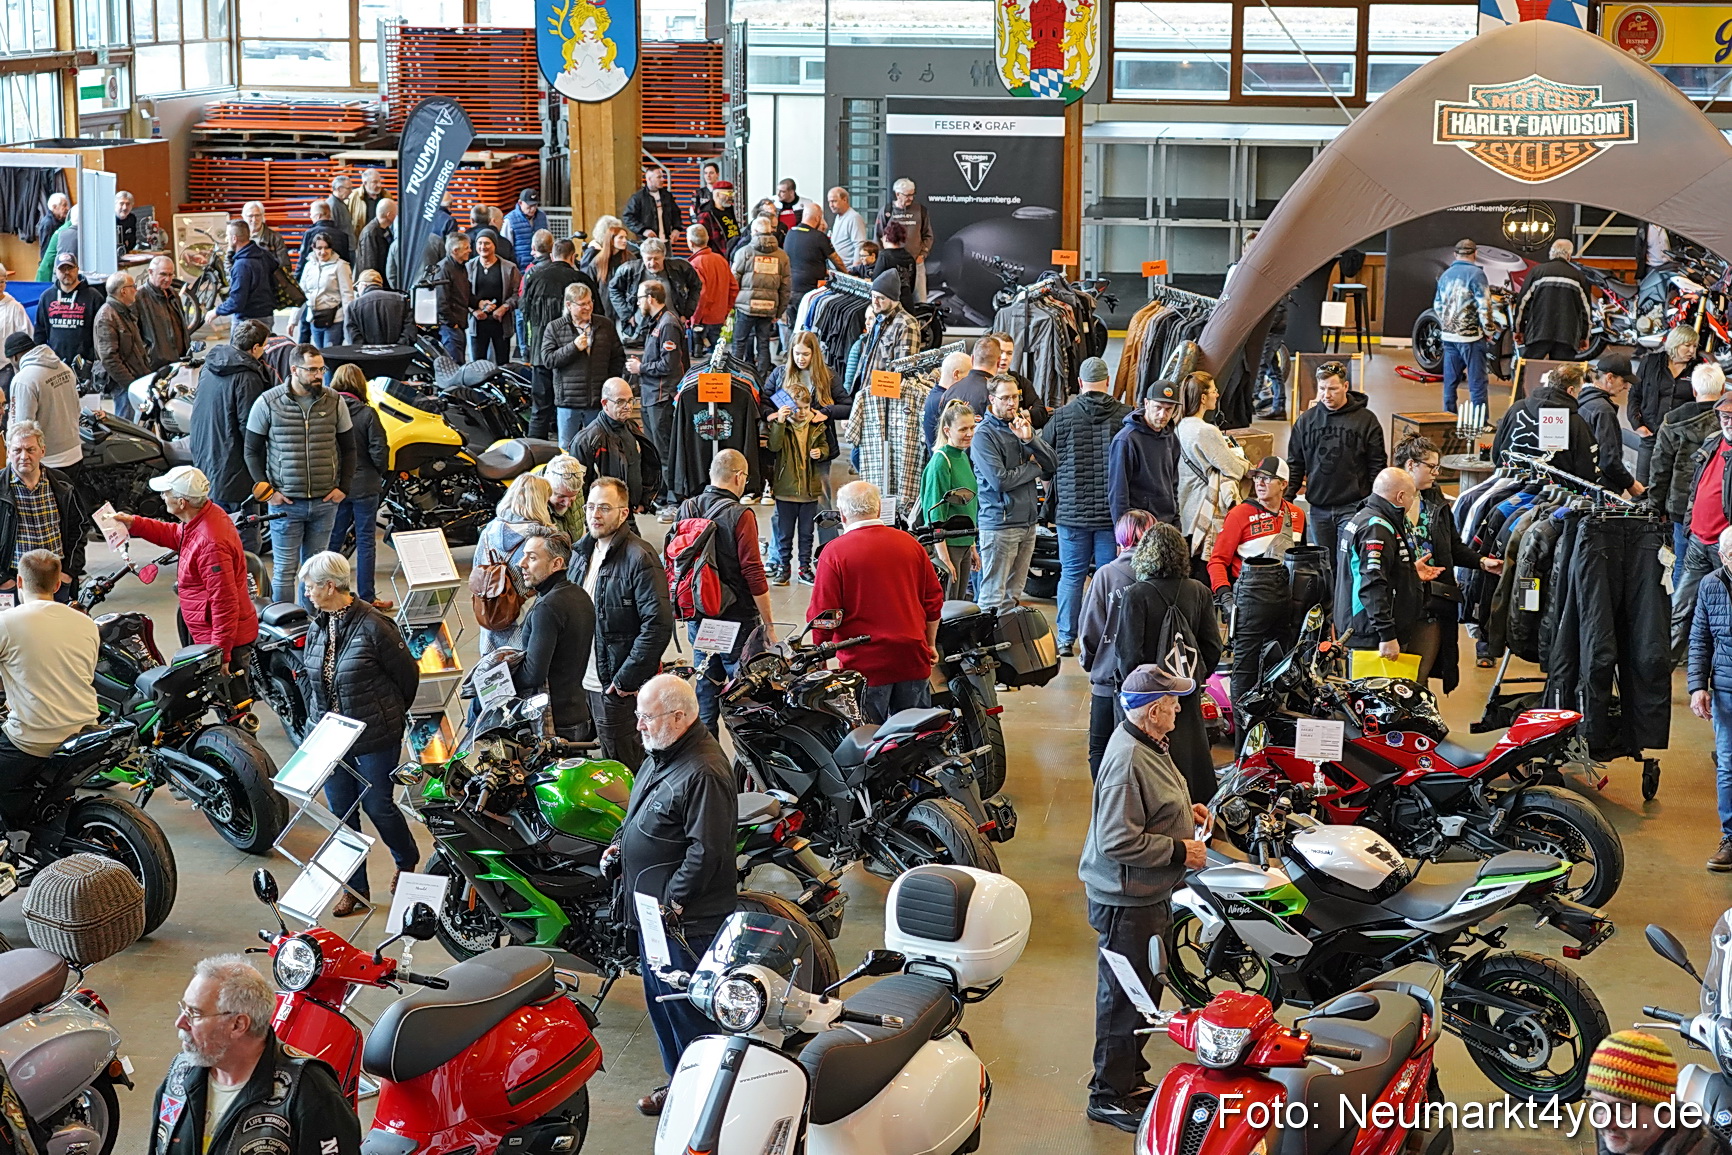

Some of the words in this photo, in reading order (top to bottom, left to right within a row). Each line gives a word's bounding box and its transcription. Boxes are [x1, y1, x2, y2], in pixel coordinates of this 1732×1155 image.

[1491, 87, 1582, 109] MOTOR
[934, 120, 971, 130] FESER
[984, 121, 1017, 131] GRAF
[1451, 112, 1620, 136] HARLEY-DAVIDSON
[406, 125, 446, 195] TRIUMPH
[961, 154, 989, 162] TRIUMPH
[1489, 142, 1581, 172] CYCLES
[422, 159, 455, 223] NÜRNBERG
[928, 194, 1022, 205] www.triumph-nuernberg.de
[1542, 416, 1554, 424] 20
[1555, 416, 1564, 424] %
[1228, 904, 1253, 917] Ninja
[248, 1117, 263, 1127] LIFE
[264, 1116, 287, 1129] MEMBER
[253, 1144, 279, 1153] GERMANY
[268, 1139, 288, 1154] CHAPTER
